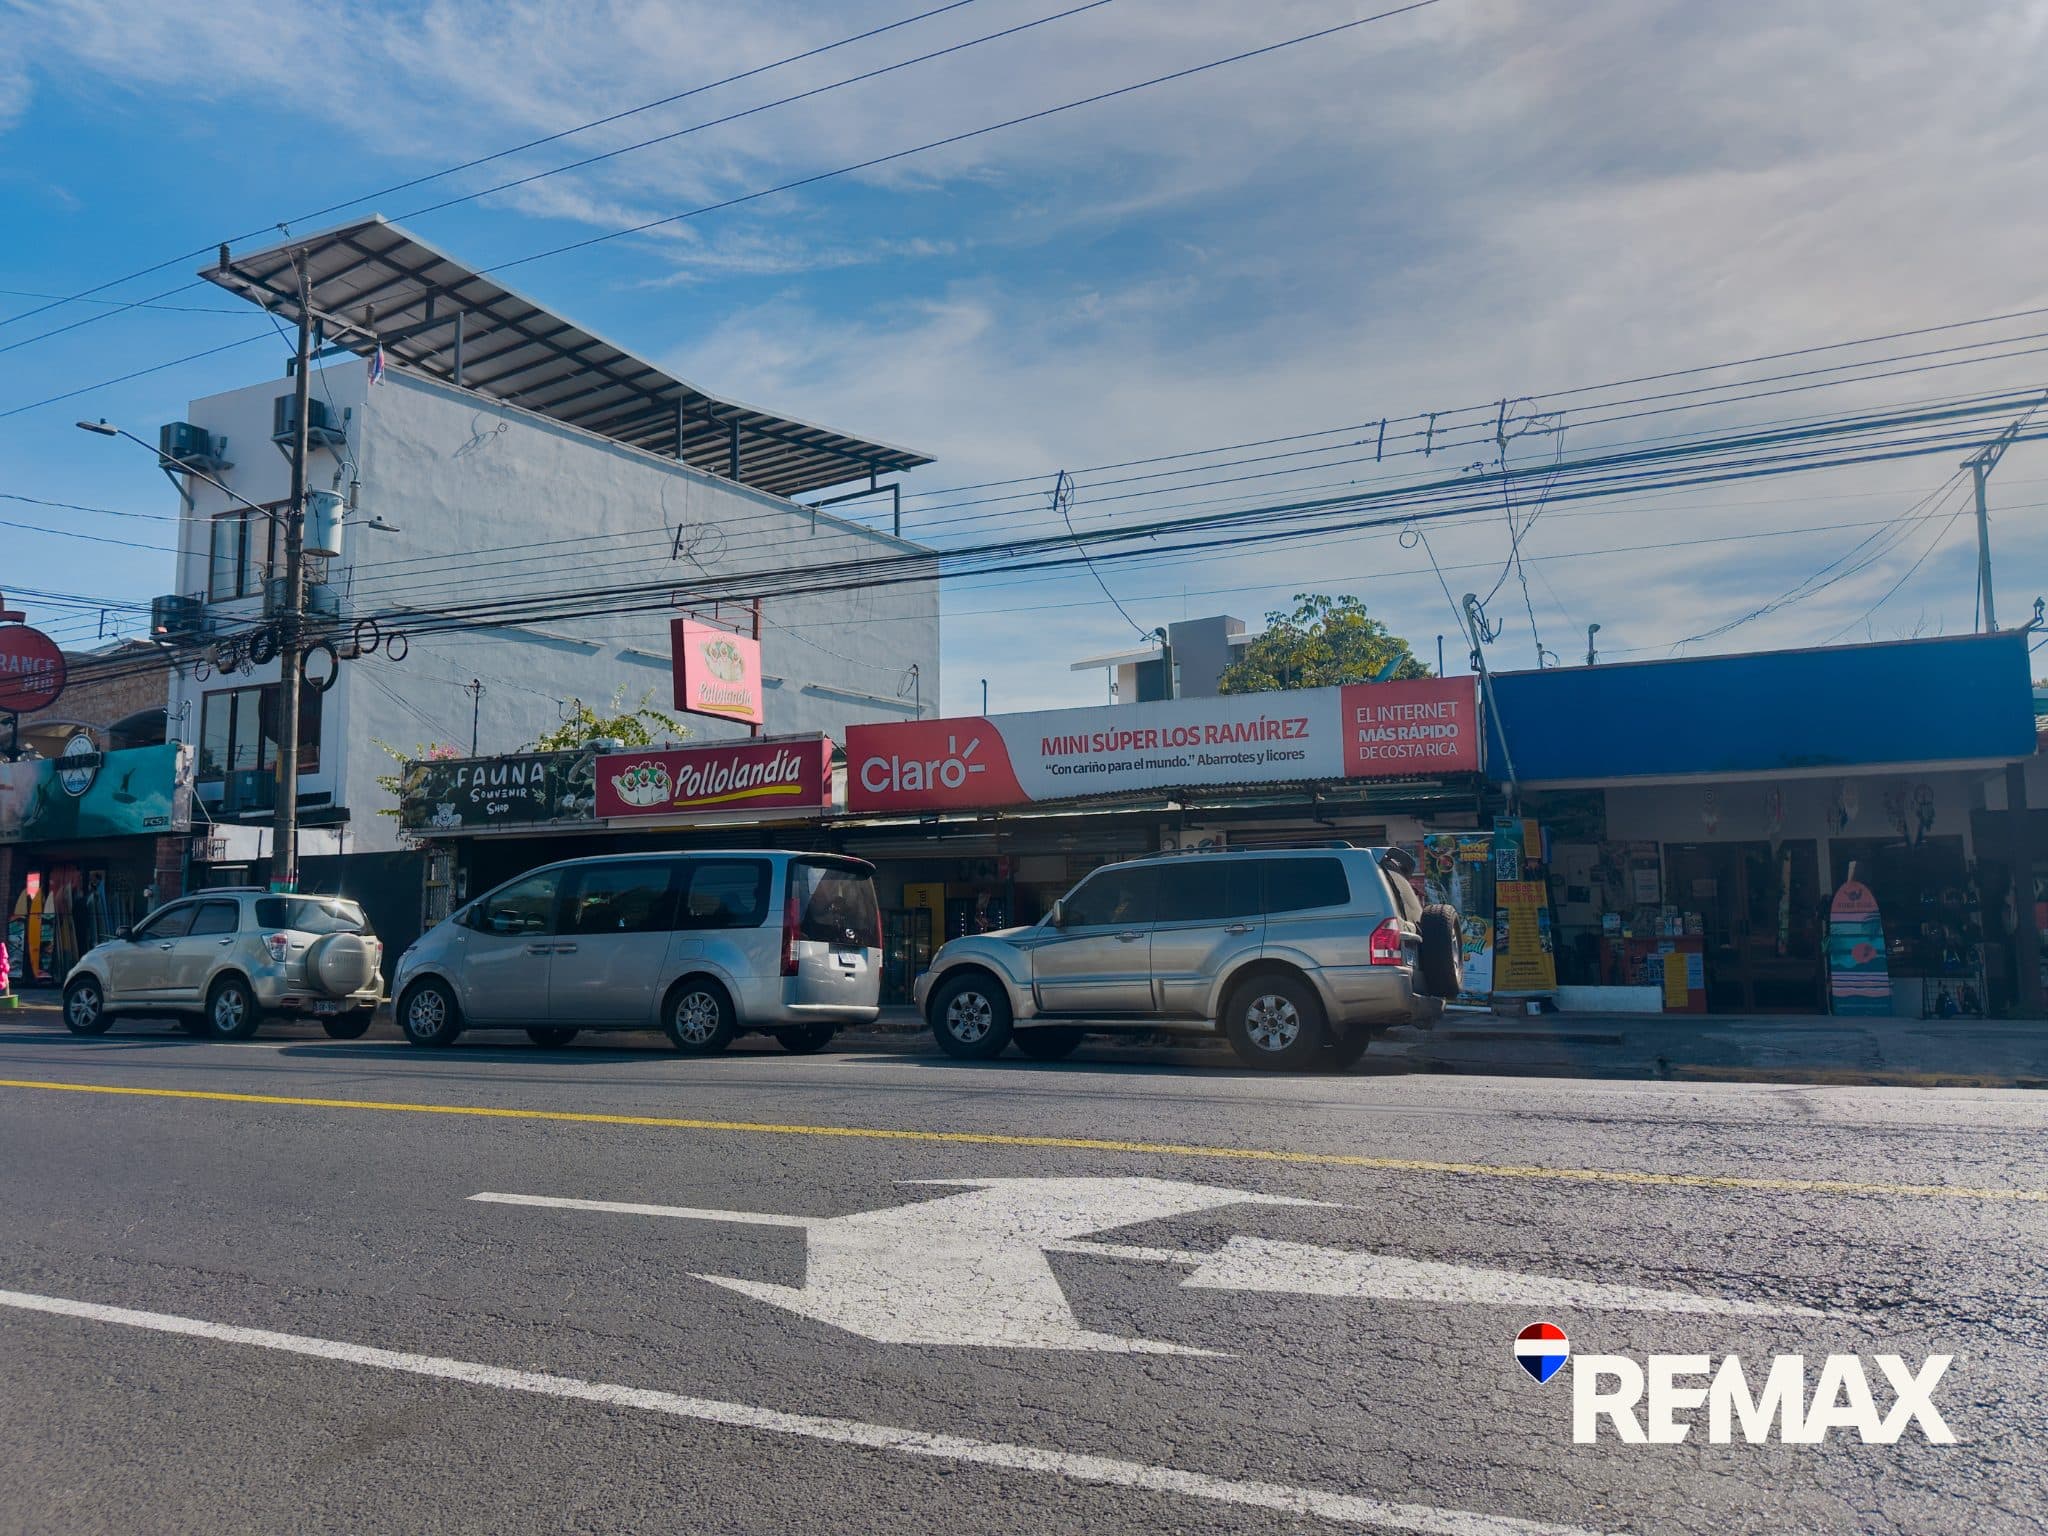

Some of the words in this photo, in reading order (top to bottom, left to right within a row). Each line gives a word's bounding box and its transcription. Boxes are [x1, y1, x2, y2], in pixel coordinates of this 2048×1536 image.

[698, 680, 753, 706] Pollolandia
[1356, 707, 1376, 724] EL
[1378, 701, 1459, 722] INTERNET
[1041, 735, 1089, 756] MINI
[1092, 727, 1158, 753] SÚPER
[1162, 725, 1201, 748] LOS
[1204, 715, 1309, 745] RAMÍREZ
[1358, 724, 1397, 743] MÁS
[1398, 722, 1459, 741] RÁPIDO
[1073, 760, 1107, 774] cariño
[1108, 760, 1132, 774] para
[1133, 758, 1145, 771] el
[1197, 752, 1256, 766] Abarrotes
[1256, 755, 1265, 769] y
[1266, 749, 1306, 762] licores
[1359, 746, 1379, 760] DE
[1379, 744, 1425, 759] COSTA
[1426, 742, 1459, 757] RICA
[456, 762, 545, 787] FAUNA
[673, 749, 803, 798] Pollolandia
[860, 754, 967, 793] Claro
[470, 788, 528, 803] SOUVENIR
